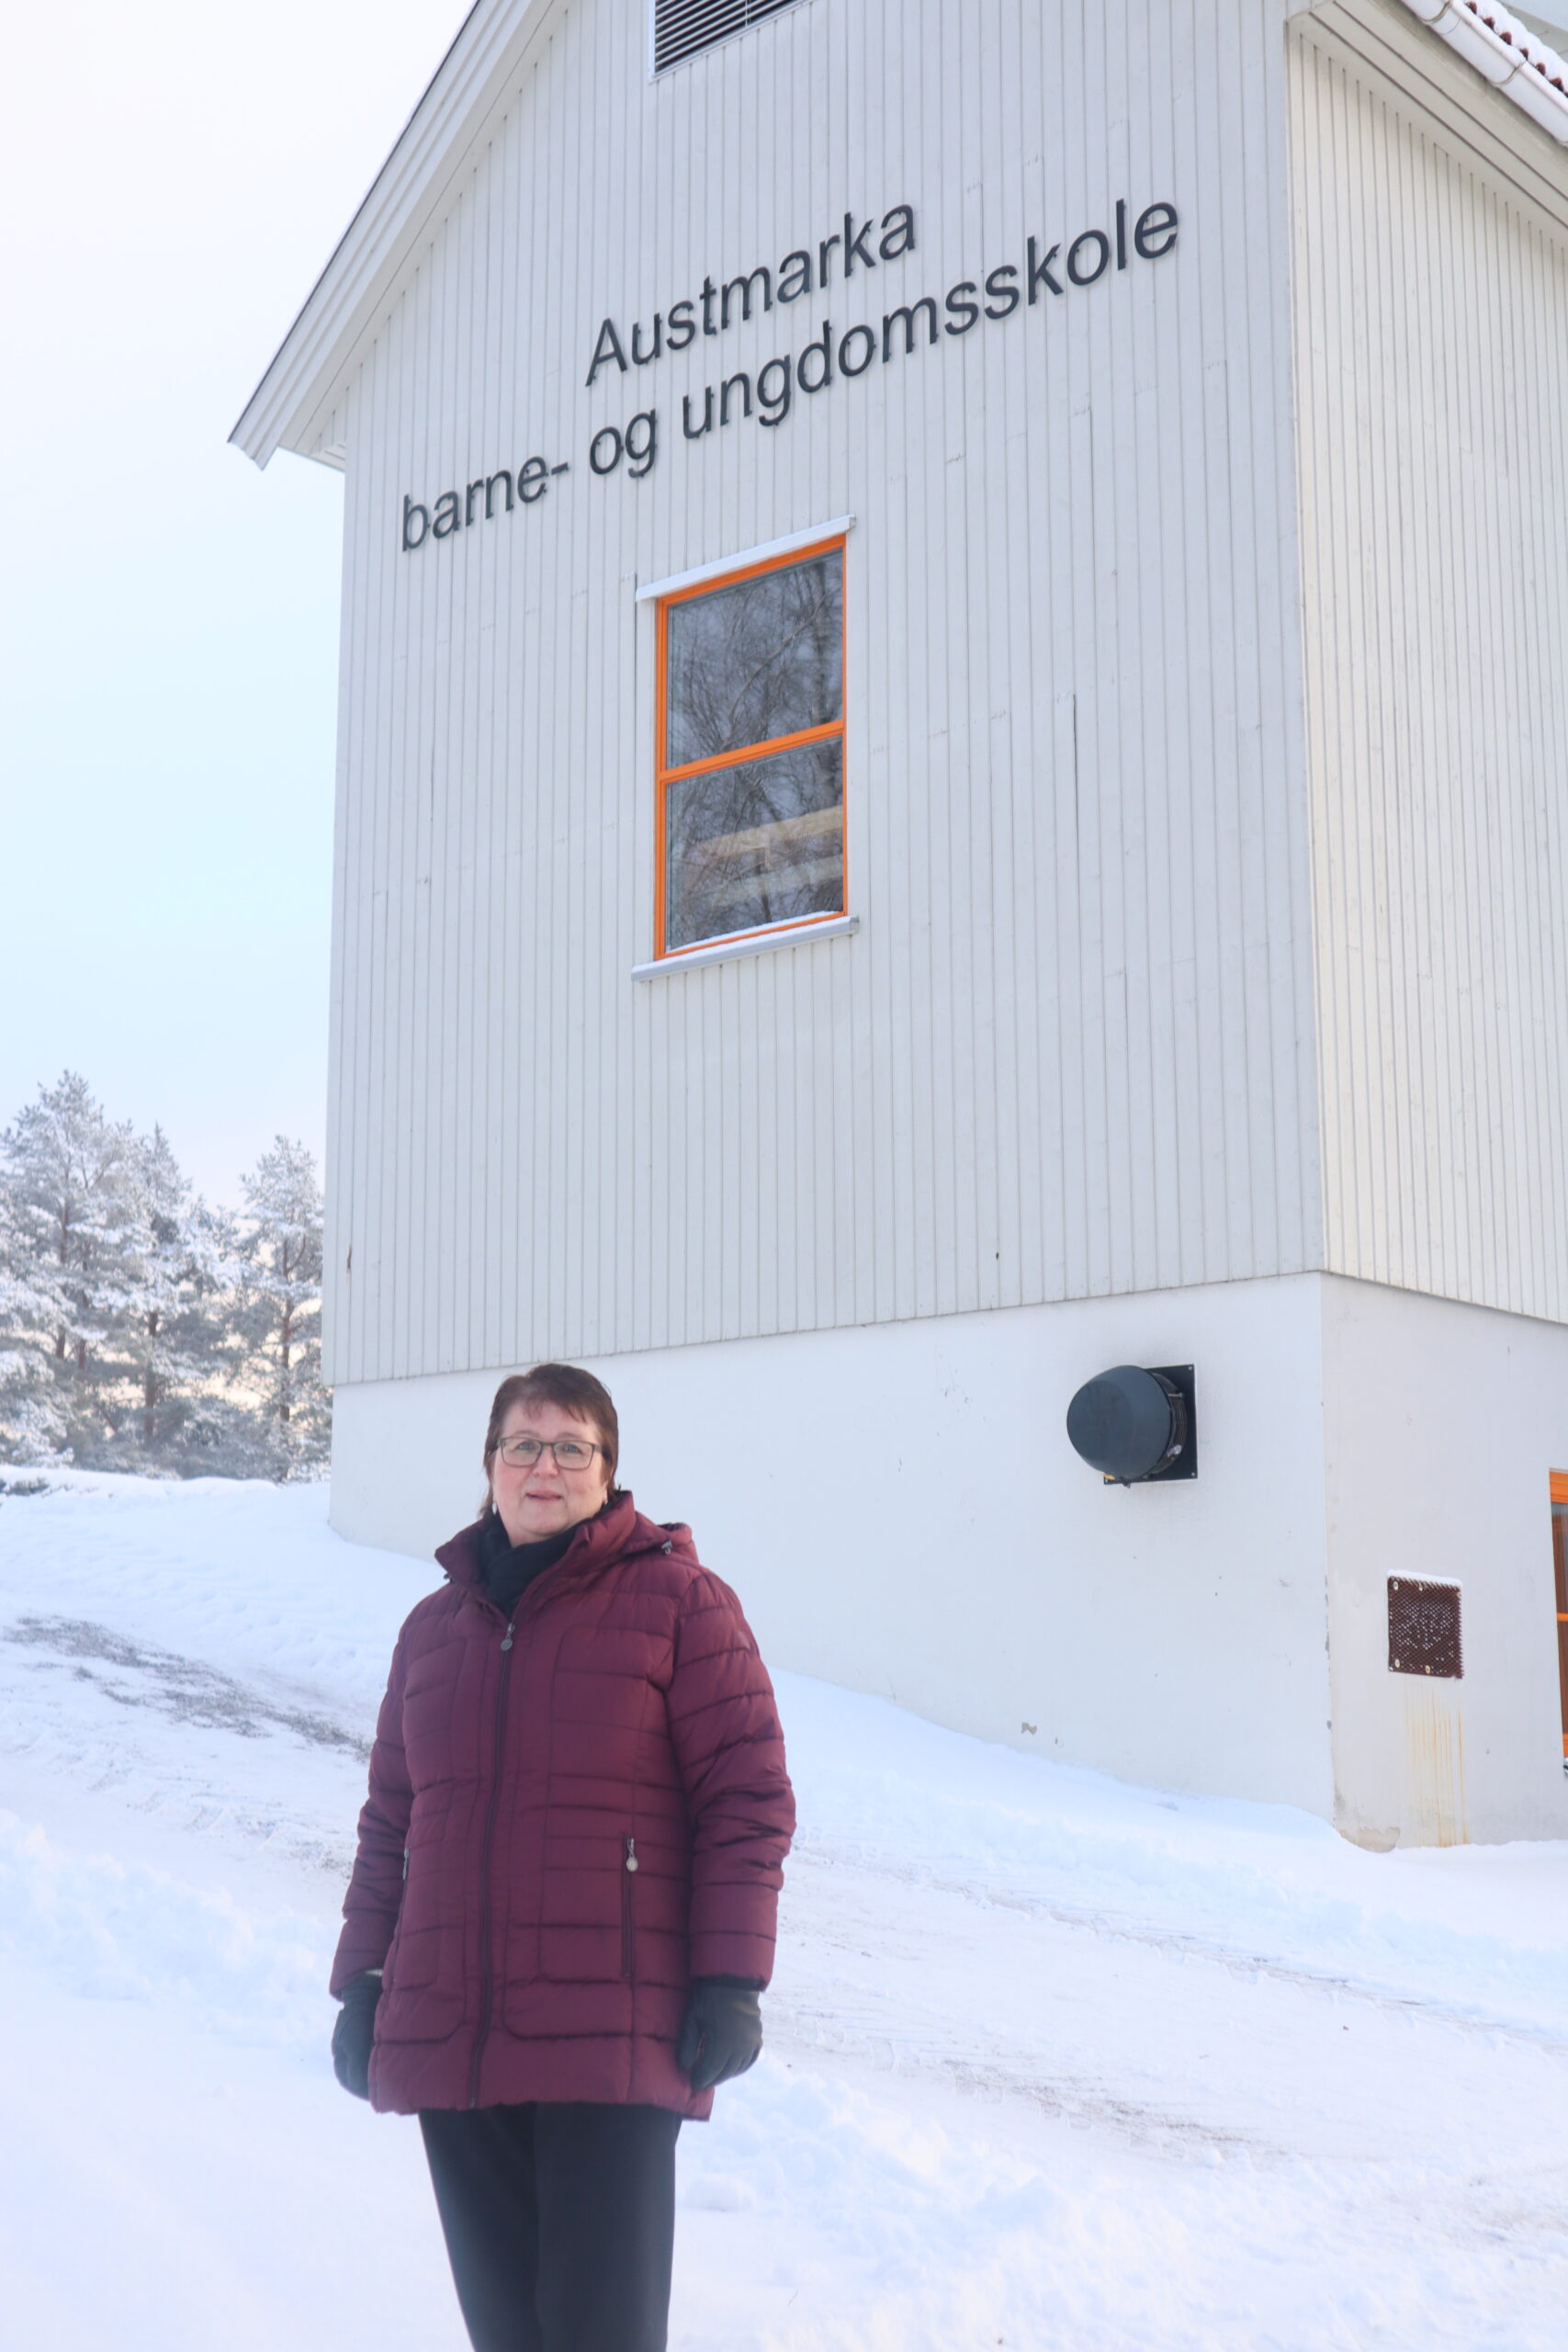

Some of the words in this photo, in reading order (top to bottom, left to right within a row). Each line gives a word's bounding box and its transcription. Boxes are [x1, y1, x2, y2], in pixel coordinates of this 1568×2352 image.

[402, 457, 570, 552] barne-
[589, 408, 659, 479] og
[682, 198, 1179, 440] ungdomsskole
[585, 204, 917, 387] Austmarka
